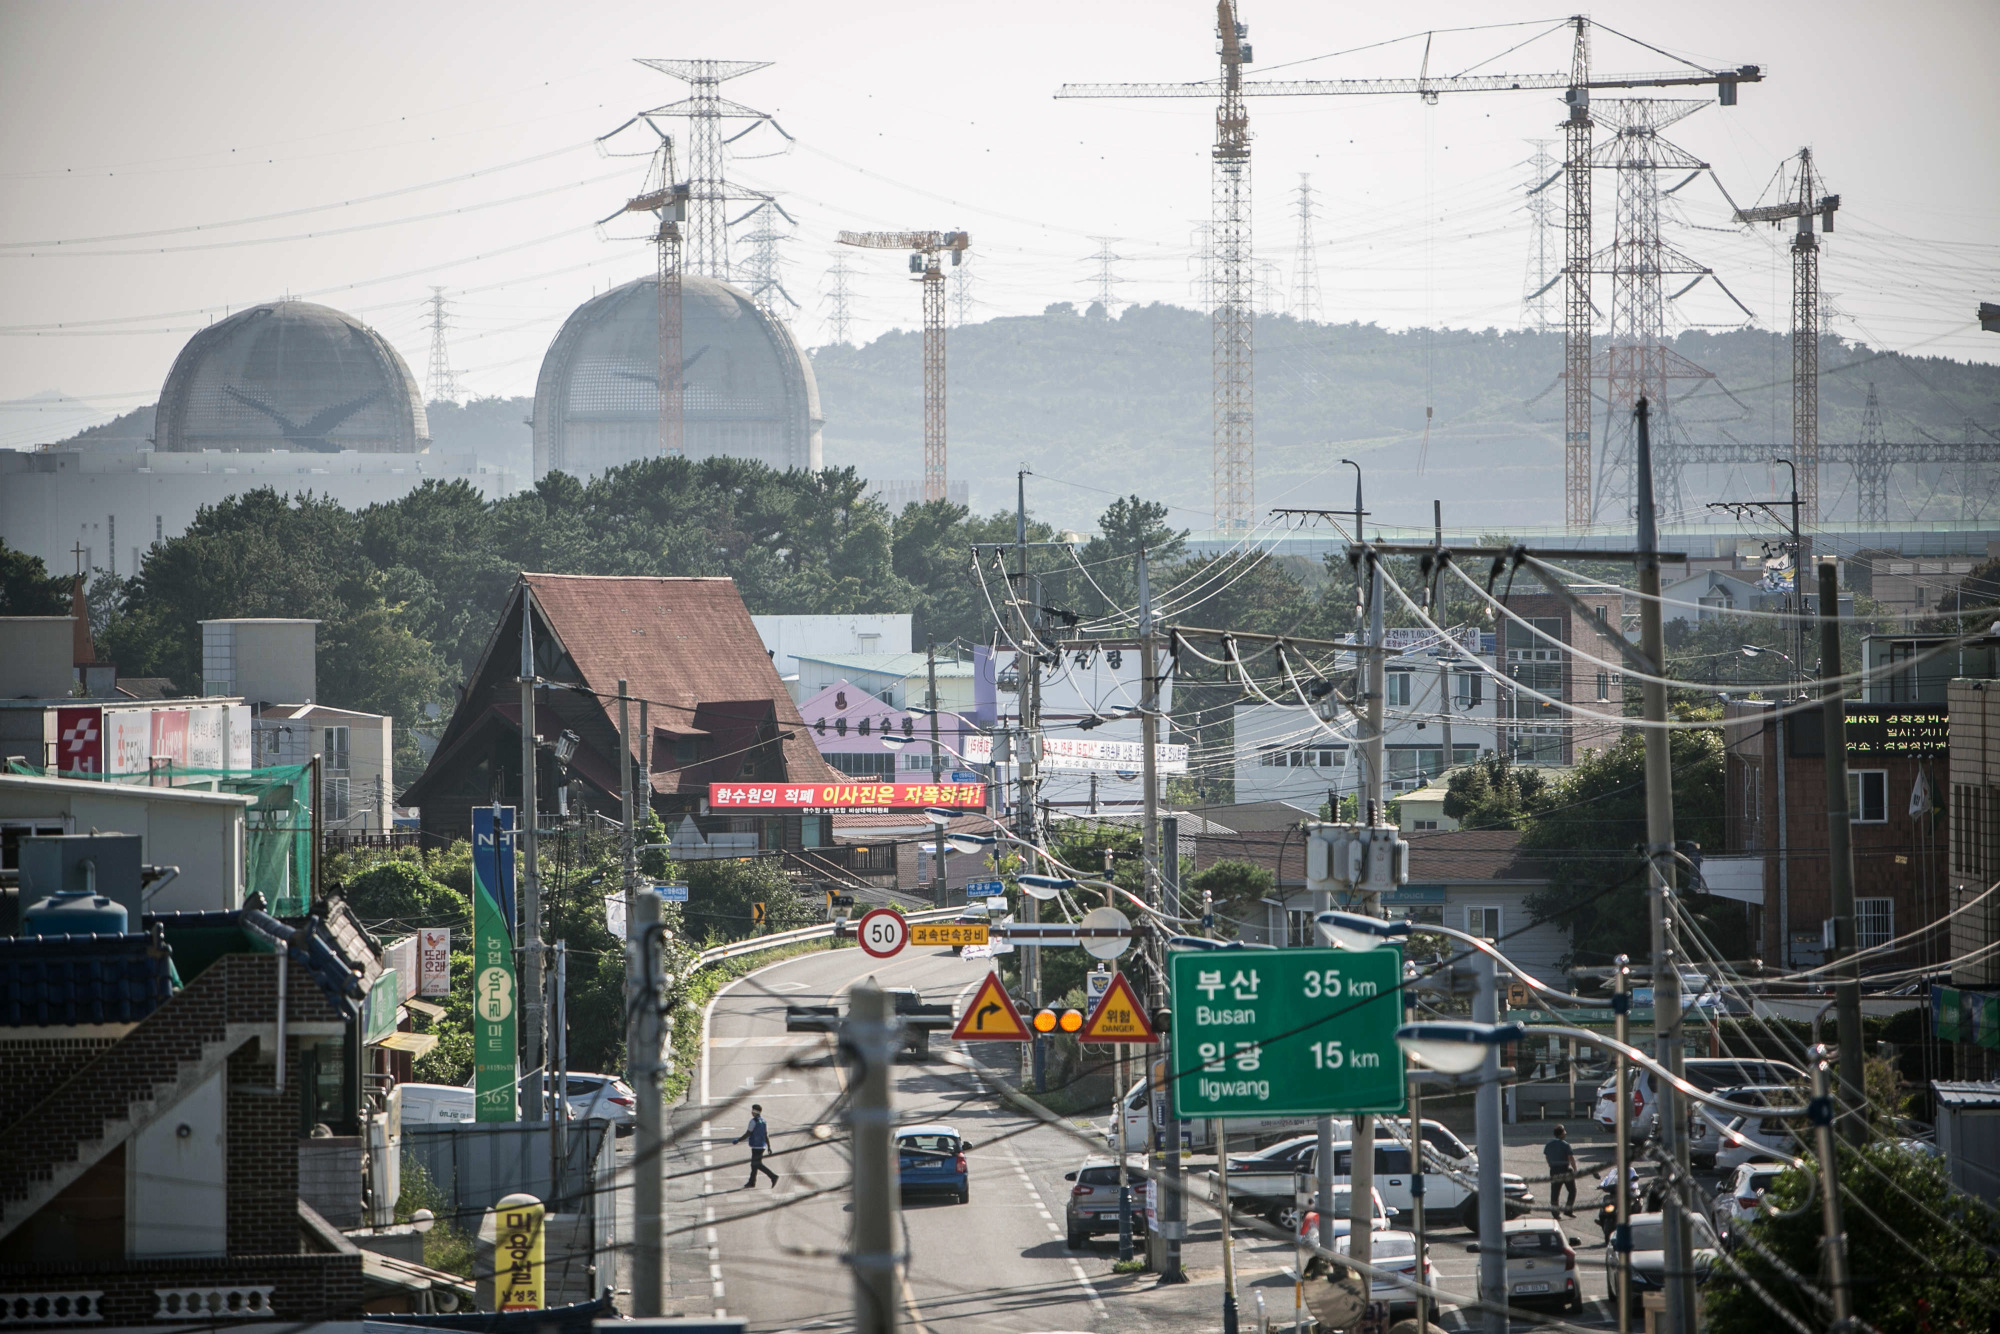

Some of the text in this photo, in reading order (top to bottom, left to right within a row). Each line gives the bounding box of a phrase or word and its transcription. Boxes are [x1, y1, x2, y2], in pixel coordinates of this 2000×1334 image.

[717, 786, 980, 805] 한수원의 적폐 이사진은 자폭하라!
[478, 833, 510, 846] NH
[872, 924, 895, 943] 50
[917, 929, 984, 942] 과속단속장비
[424, 950, 446, 960] 또래
[487, 936, 502, 964] 농협
[425, 961, 446, 972] 오래
[1196, 969, 1377, 1000] 부산 35 km
[1106, 1009, 1130, 1023] 위험
[1196, 1006, 1255, 1025] Busan
[488, 1025, 502, 1051] 마트
[1198, 1041, 1379, 1072] 일광 15 km
[482, 1090, 509, 1105] 365
[1199, 1079, 1270, 1101] Ilgwang
